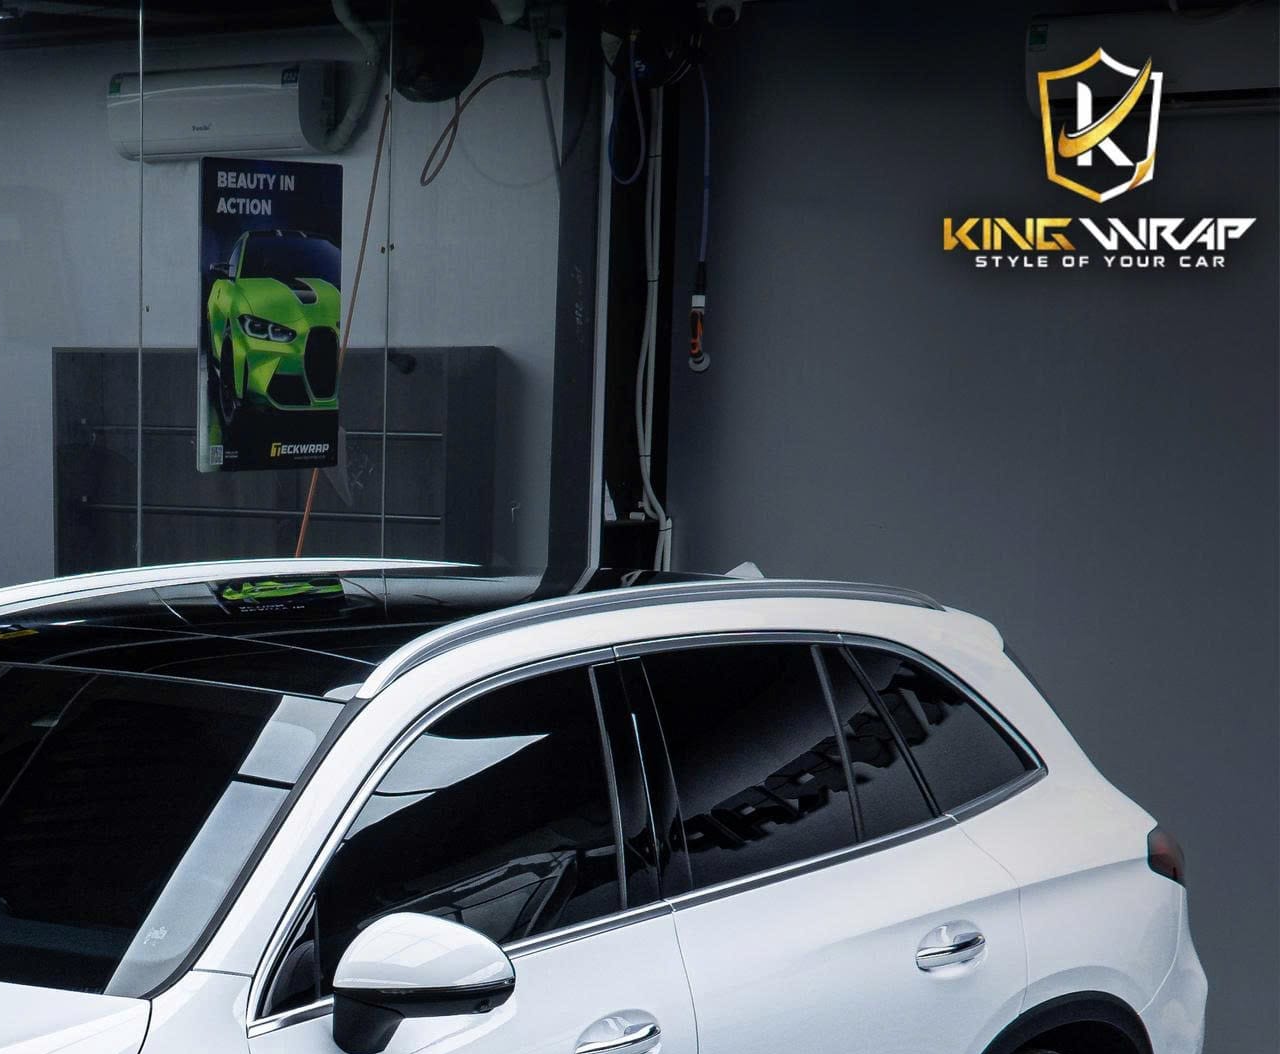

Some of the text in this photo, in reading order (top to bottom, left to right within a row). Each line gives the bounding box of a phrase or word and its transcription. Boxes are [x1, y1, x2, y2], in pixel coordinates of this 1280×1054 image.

[217, 171, 295, 191] BEAUTY IN
[217, 198, 271, 215] ACTION
[270, 442, 329, 457] TECKWRAP
